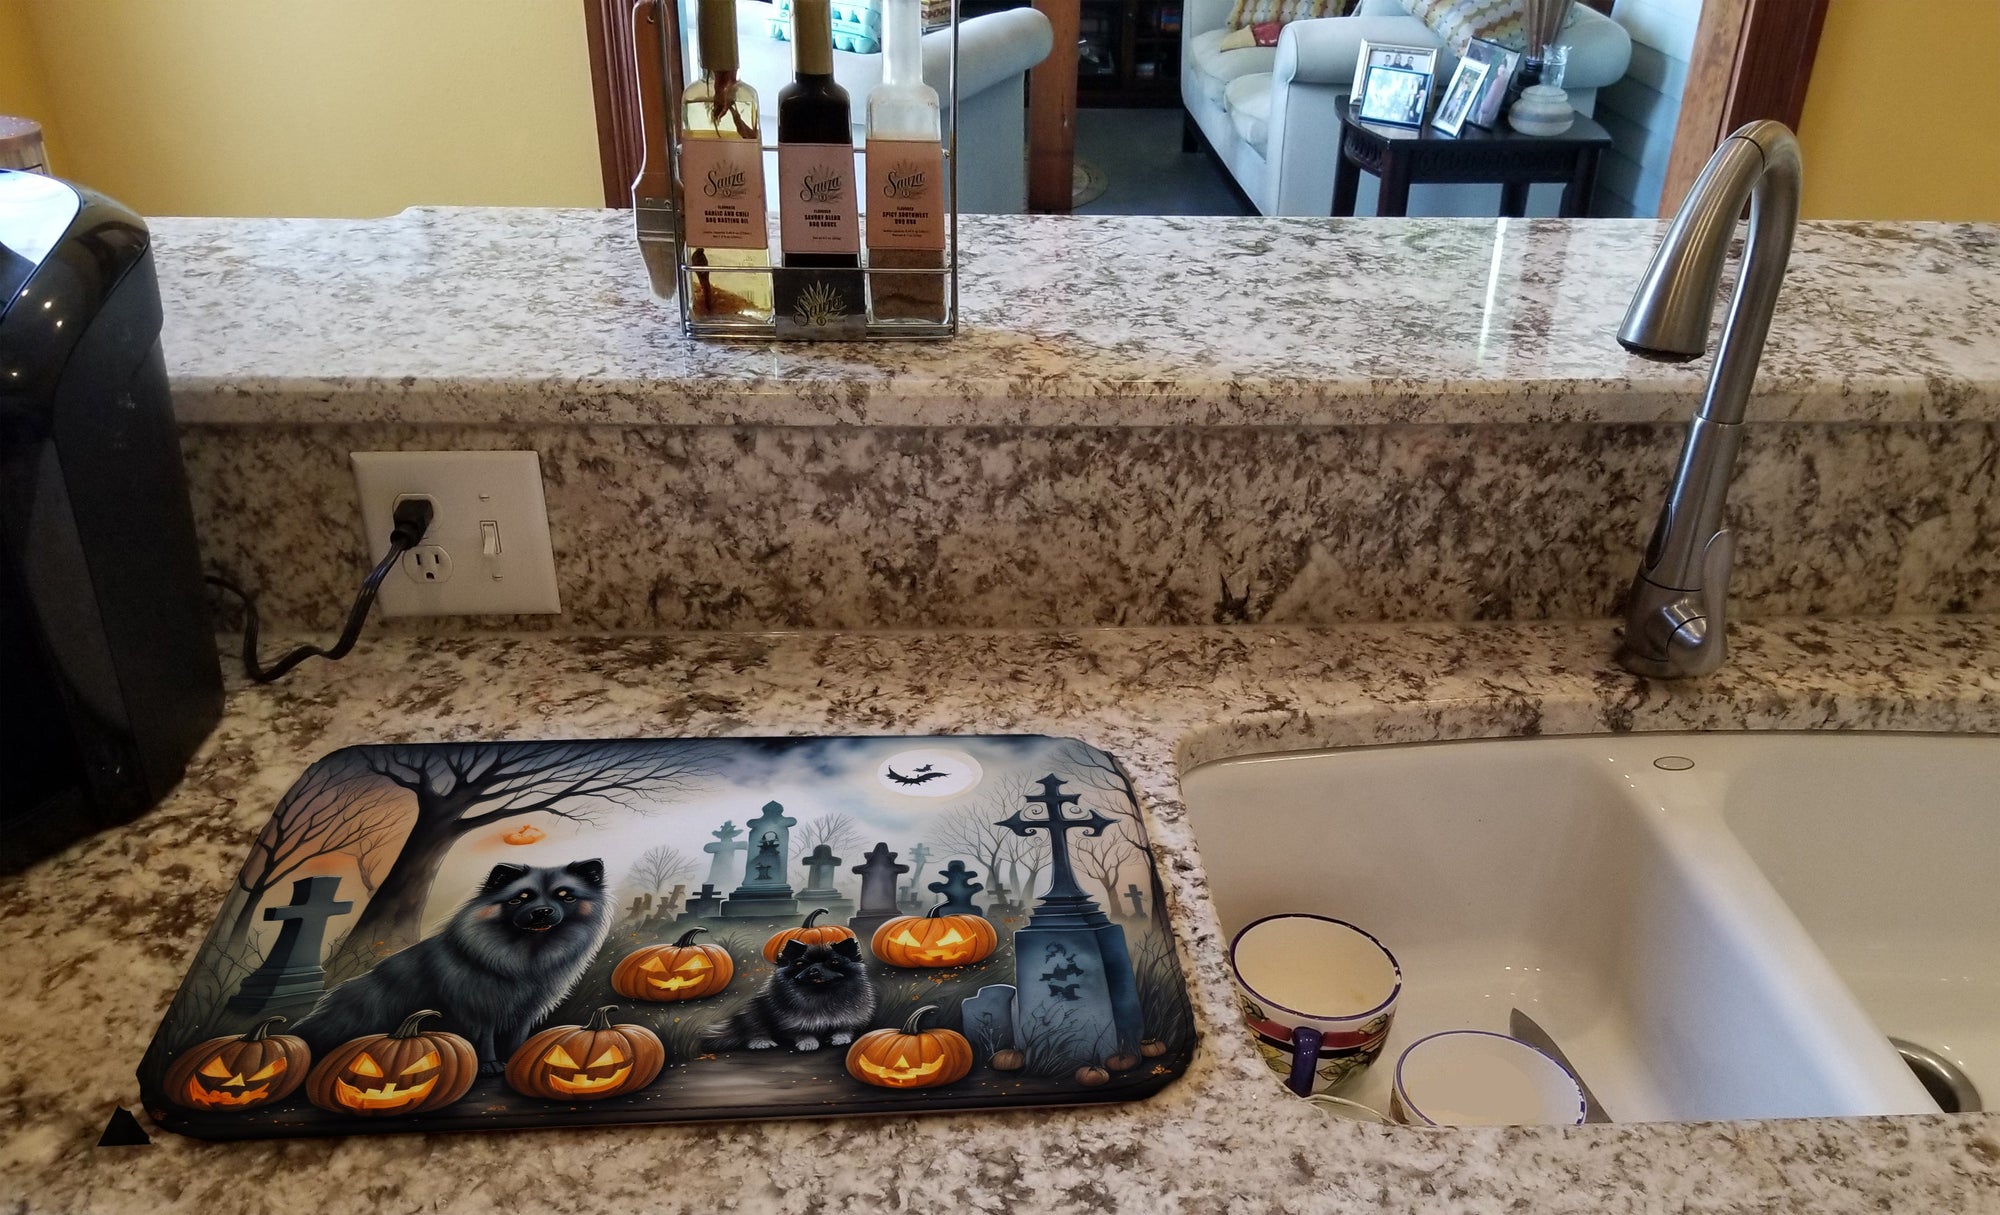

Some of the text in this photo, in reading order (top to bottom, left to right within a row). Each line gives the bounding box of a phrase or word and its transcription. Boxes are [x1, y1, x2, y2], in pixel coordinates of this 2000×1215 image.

[704, 170, 746, 197] Sauza
[800, 175, 841, 202] Sauza
[884, 171, 925, 198] Sauza
